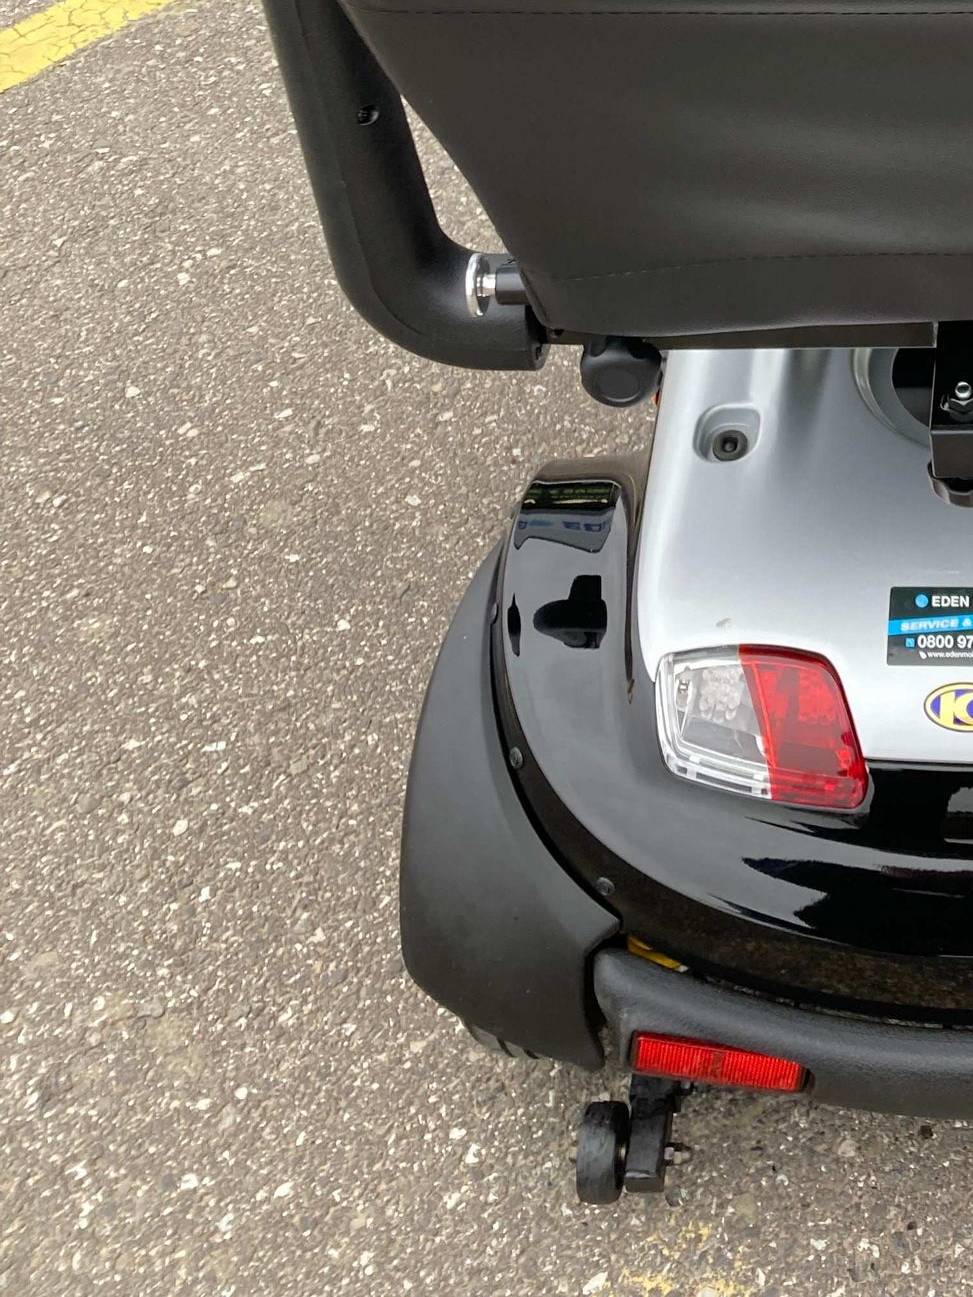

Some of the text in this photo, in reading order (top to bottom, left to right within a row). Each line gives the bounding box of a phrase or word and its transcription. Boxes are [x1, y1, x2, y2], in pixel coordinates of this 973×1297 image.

[931, 595, 970, 608] EDEN
[901, 618, 959, 632] SERVICE
[962, 617, 972, 627] &
[917, 634, 954, 648] 0800
